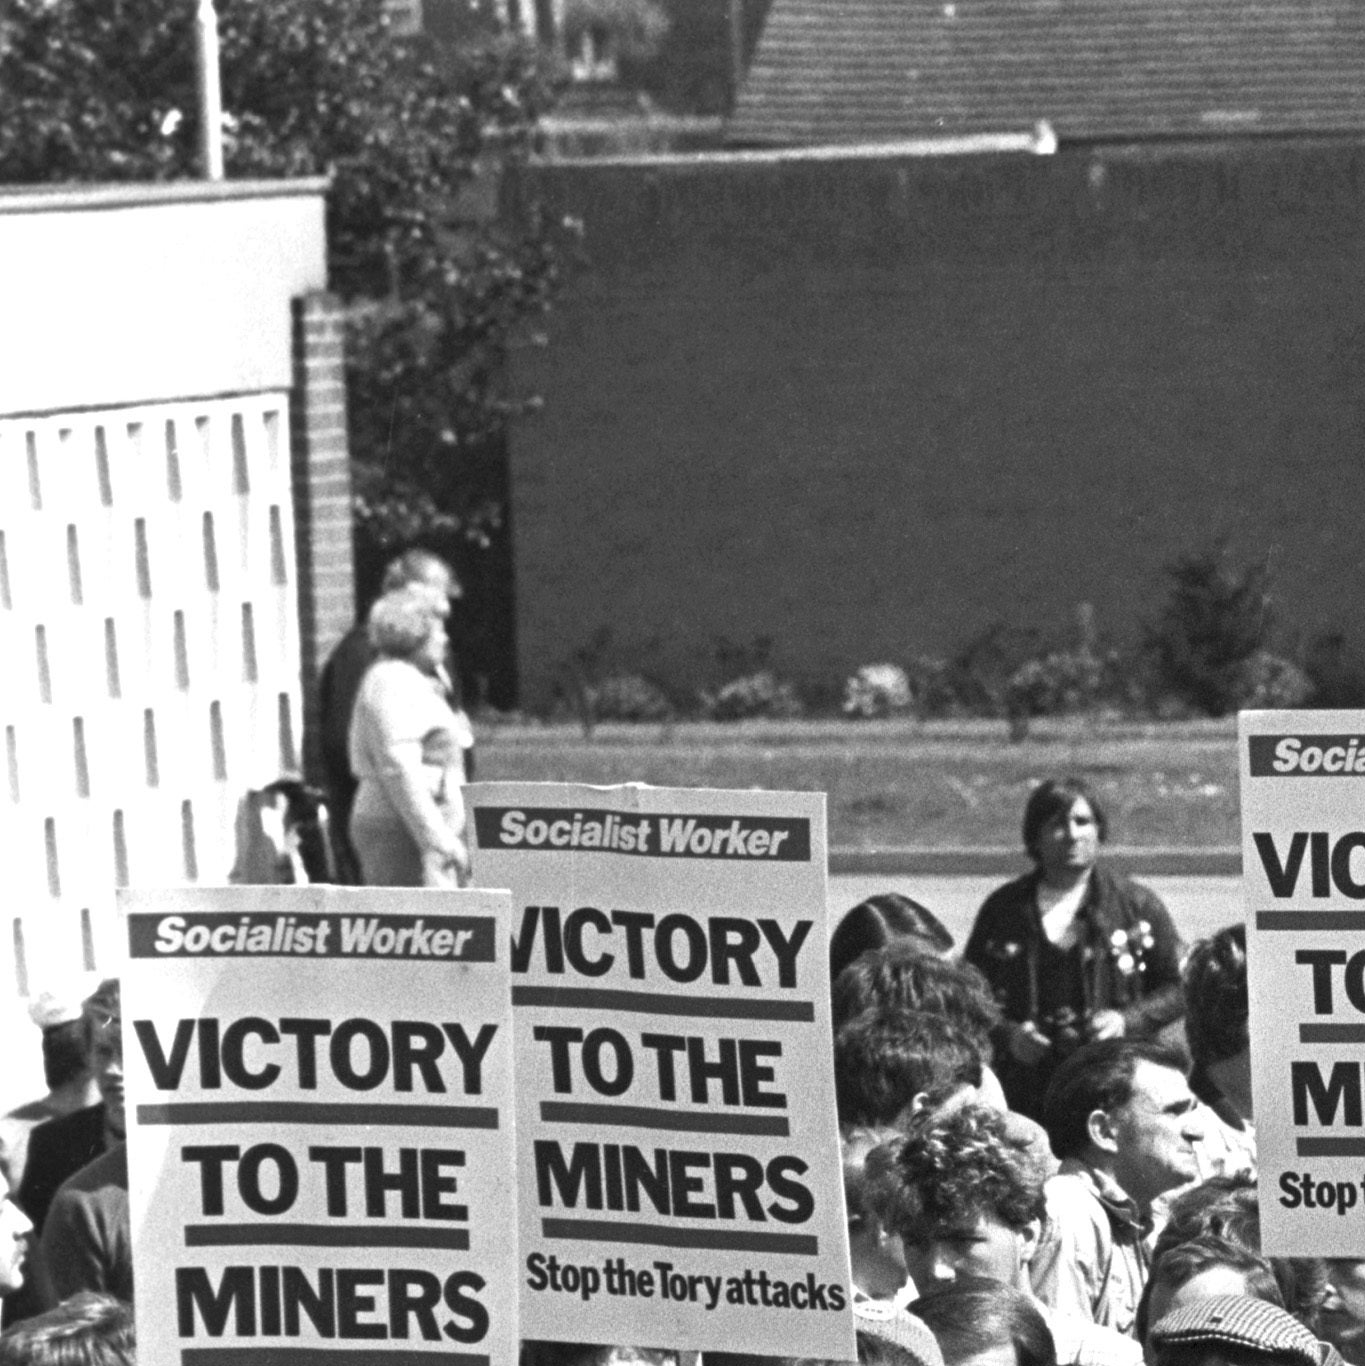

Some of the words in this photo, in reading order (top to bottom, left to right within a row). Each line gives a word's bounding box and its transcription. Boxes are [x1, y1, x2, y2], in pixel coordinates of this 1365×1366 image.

[500, 811, 651, 851] Socialist
[660, 819, 788, 855] Worker
[155, 917, 330, 953] Socialist
[341, 919, 472, 955] Worker
[511, 906, 813, 988] VICTORY
[134, 1017, 498, 1095] VICTORY
[534, 1026, 633, 1096] TO
[641, 1033, 787, 1108] THE
[182, 1143, 298, 1216] TO
[309, 1146, 468, 1221] THE
[534, 1140, 814, 1224] MINERS
[1279, 1171, 1357, 1215] Stop
[176, 1266, 489, 1343] MINERS
[527, 1253, 600, 1301] Stop
[603, 1258, 654, 1297] the
[654, 1261, 722, 1310] Tory
[726, 1270, 845, 1311] attacks
